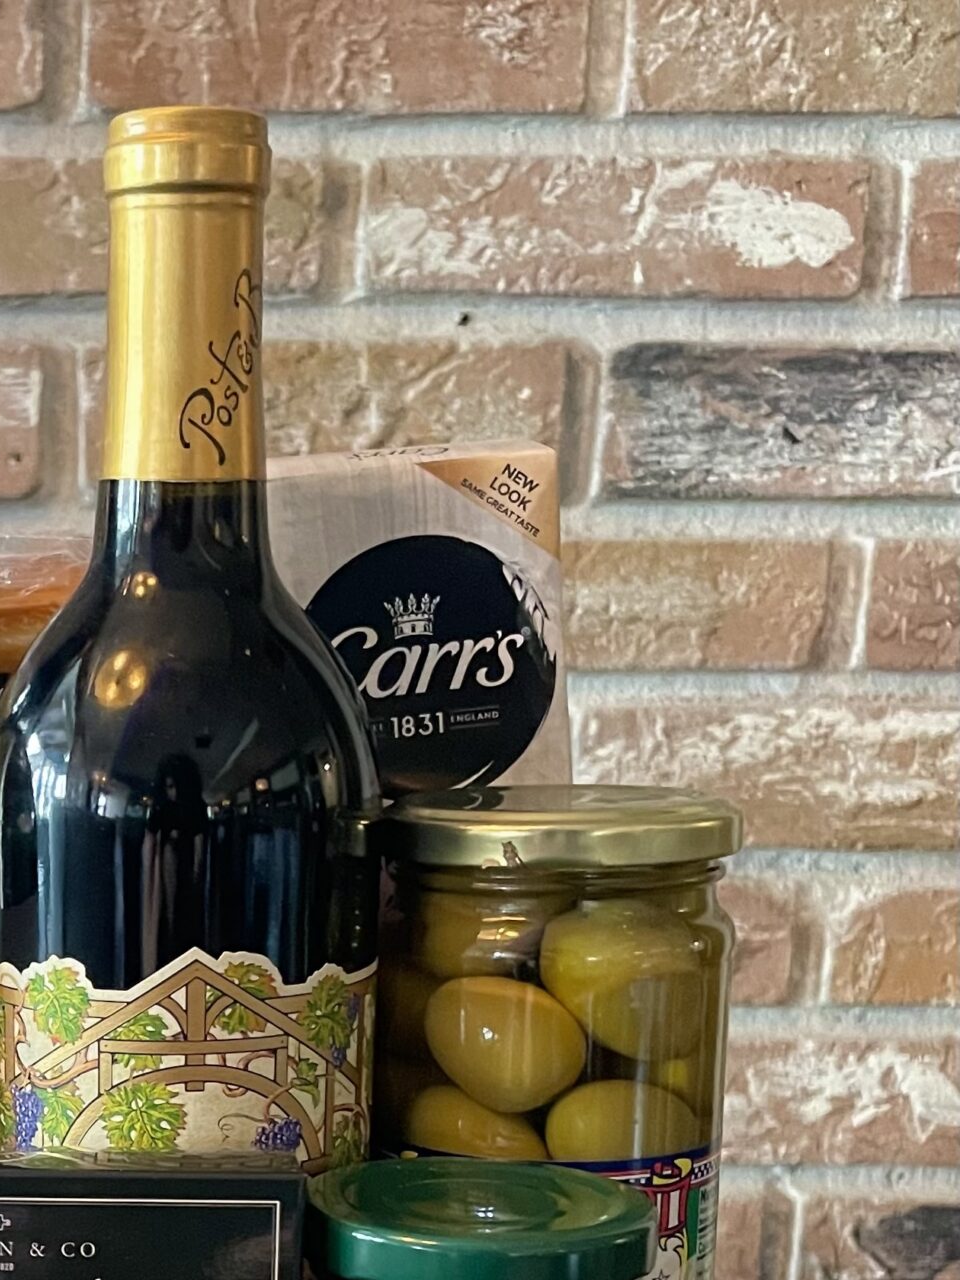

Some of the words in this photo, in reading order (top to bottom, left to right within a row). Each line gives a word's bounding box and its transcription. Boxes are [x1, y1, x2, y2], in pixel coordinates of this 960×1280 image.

[502, 464, 539, 492] NEW
[461, 478, 486, 500] SAME
[486, 496, 515, 519] GREAT
[514, 514, 540, 537] TASTE
[489, 477, 532, 512] LOOK
[390, 711, 444, 738] 1831
[450, 710, 499, 723] ENGLAND
[29, 1242, 45, 1257] &
[60, 1242, 96, 1258] CO
